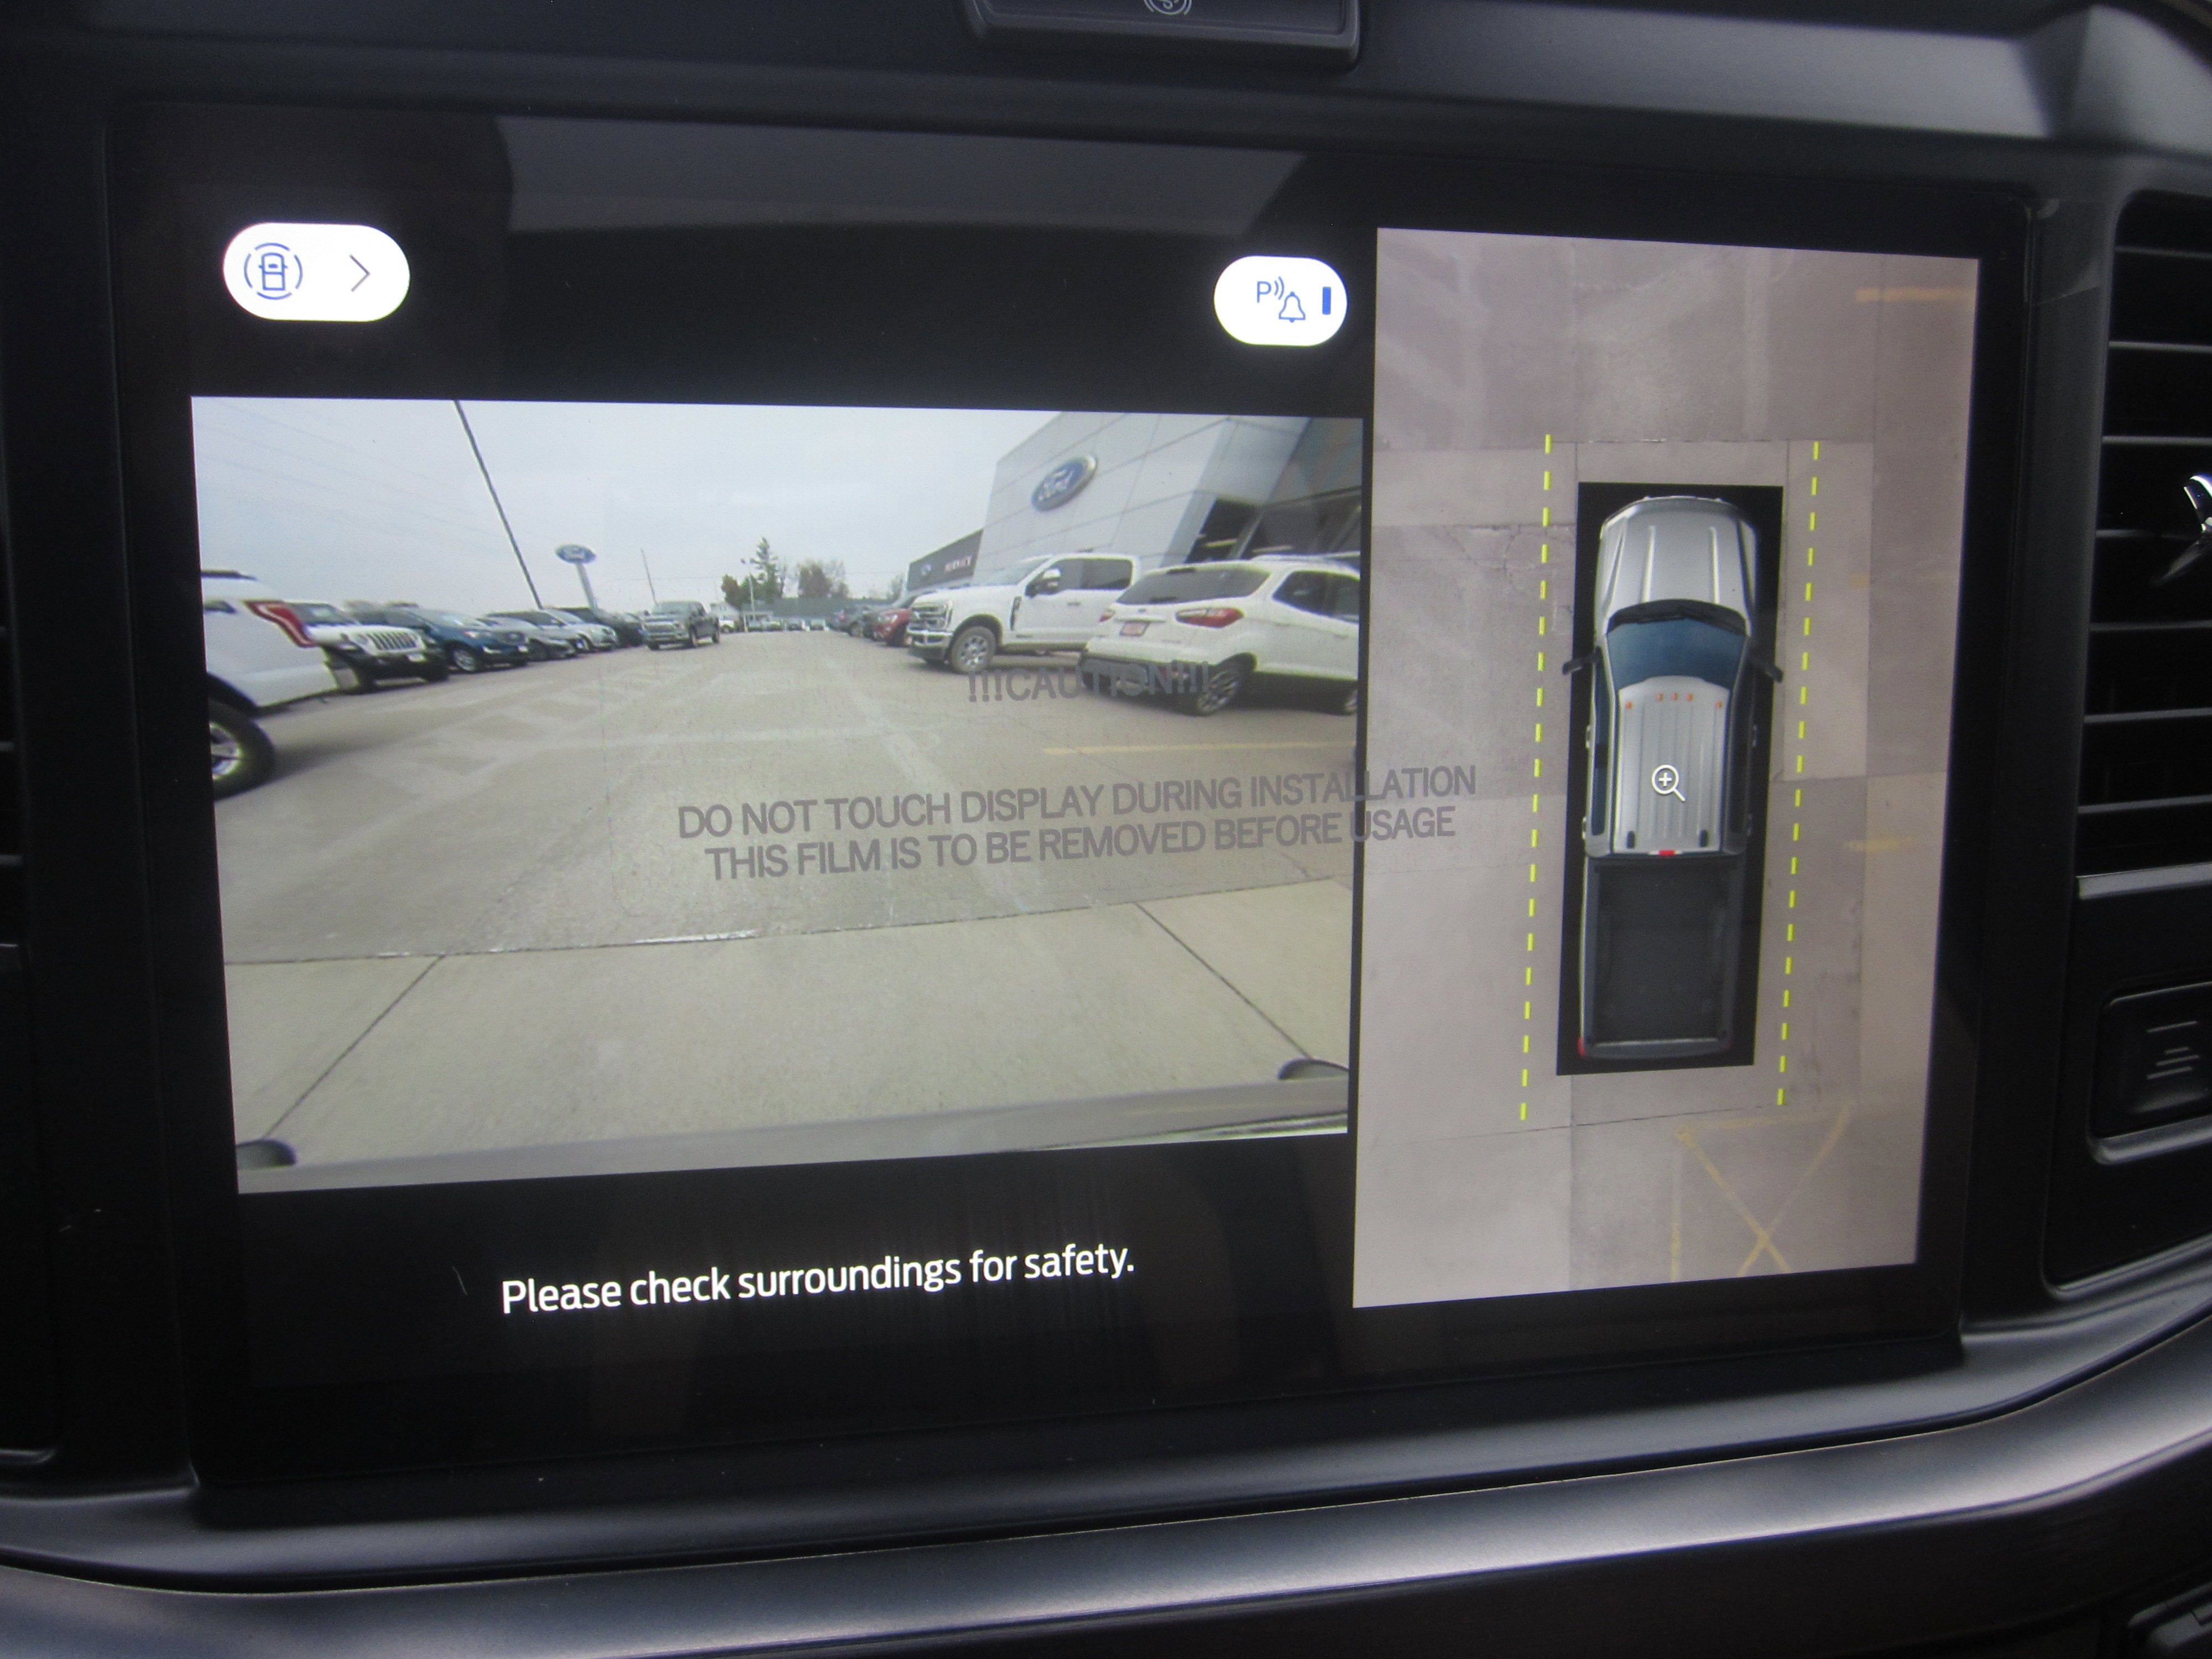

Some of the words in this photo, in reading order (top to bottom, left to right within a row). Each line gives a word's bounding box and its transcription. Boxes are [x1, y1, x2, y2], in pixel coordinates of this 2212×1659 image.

[678, 804, 732, 838] DO
[742, 800, 818, 835] NOT
[824, 792, 951, 830] TOUCH
[961, 784, 1104, 823] DISPLAY
[1113, 776, 1243, 815] DURING
[1251, 764, 1477, 807] INSTALLATION
[705, 844, 789, 880] THIS
[797, 838, 881, 875] FILM
[891, 836, 921, 869] IS
[927, 833, 977, 867] TO
[986, 830, 1031, 864] BE
[1039, 821, 1207, 861] REMOVED
[1214, 812, 1343, 850] BEFORE
[1349, 805, 1456, 842] USAGE
[502, 1277, 622, 1314] Please
[630, 1266, 731, 1306] check
[738, 1255, 962, 1298] surroundings
[969, 1249, 1018, 1283] for
[1024, 1243, 1134, 1279] safety.
